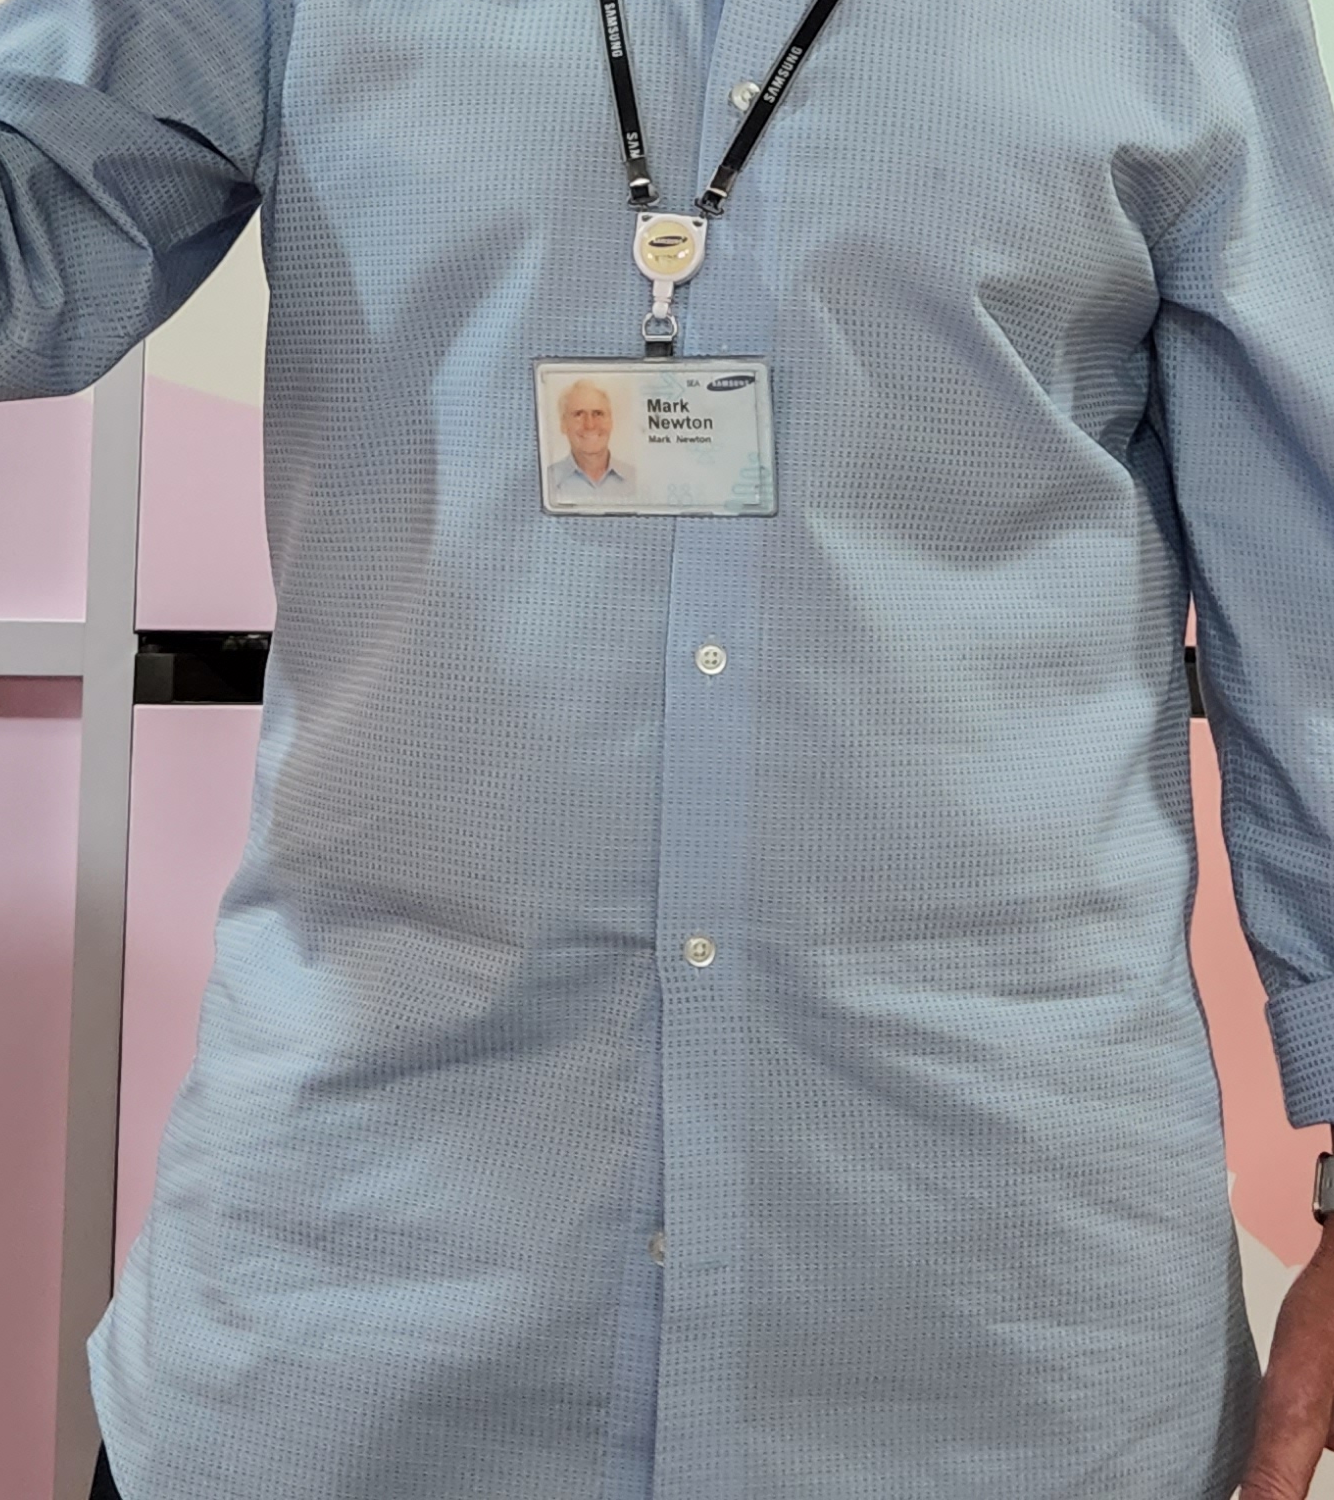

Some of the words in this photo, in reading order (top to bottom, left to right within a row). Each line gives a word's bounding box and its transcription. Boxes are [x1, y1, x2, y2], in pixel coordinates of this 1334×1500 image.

[604, 2, 624, 58] SAMSUNG
[763, 46, 803, 104] SAMSUNG
[647, 398, 690, 413] Mark
[648, 415, 714, 430] Newton
[648, 434, 671, 444] Mark
[676, 435, 712, 444] Newton
